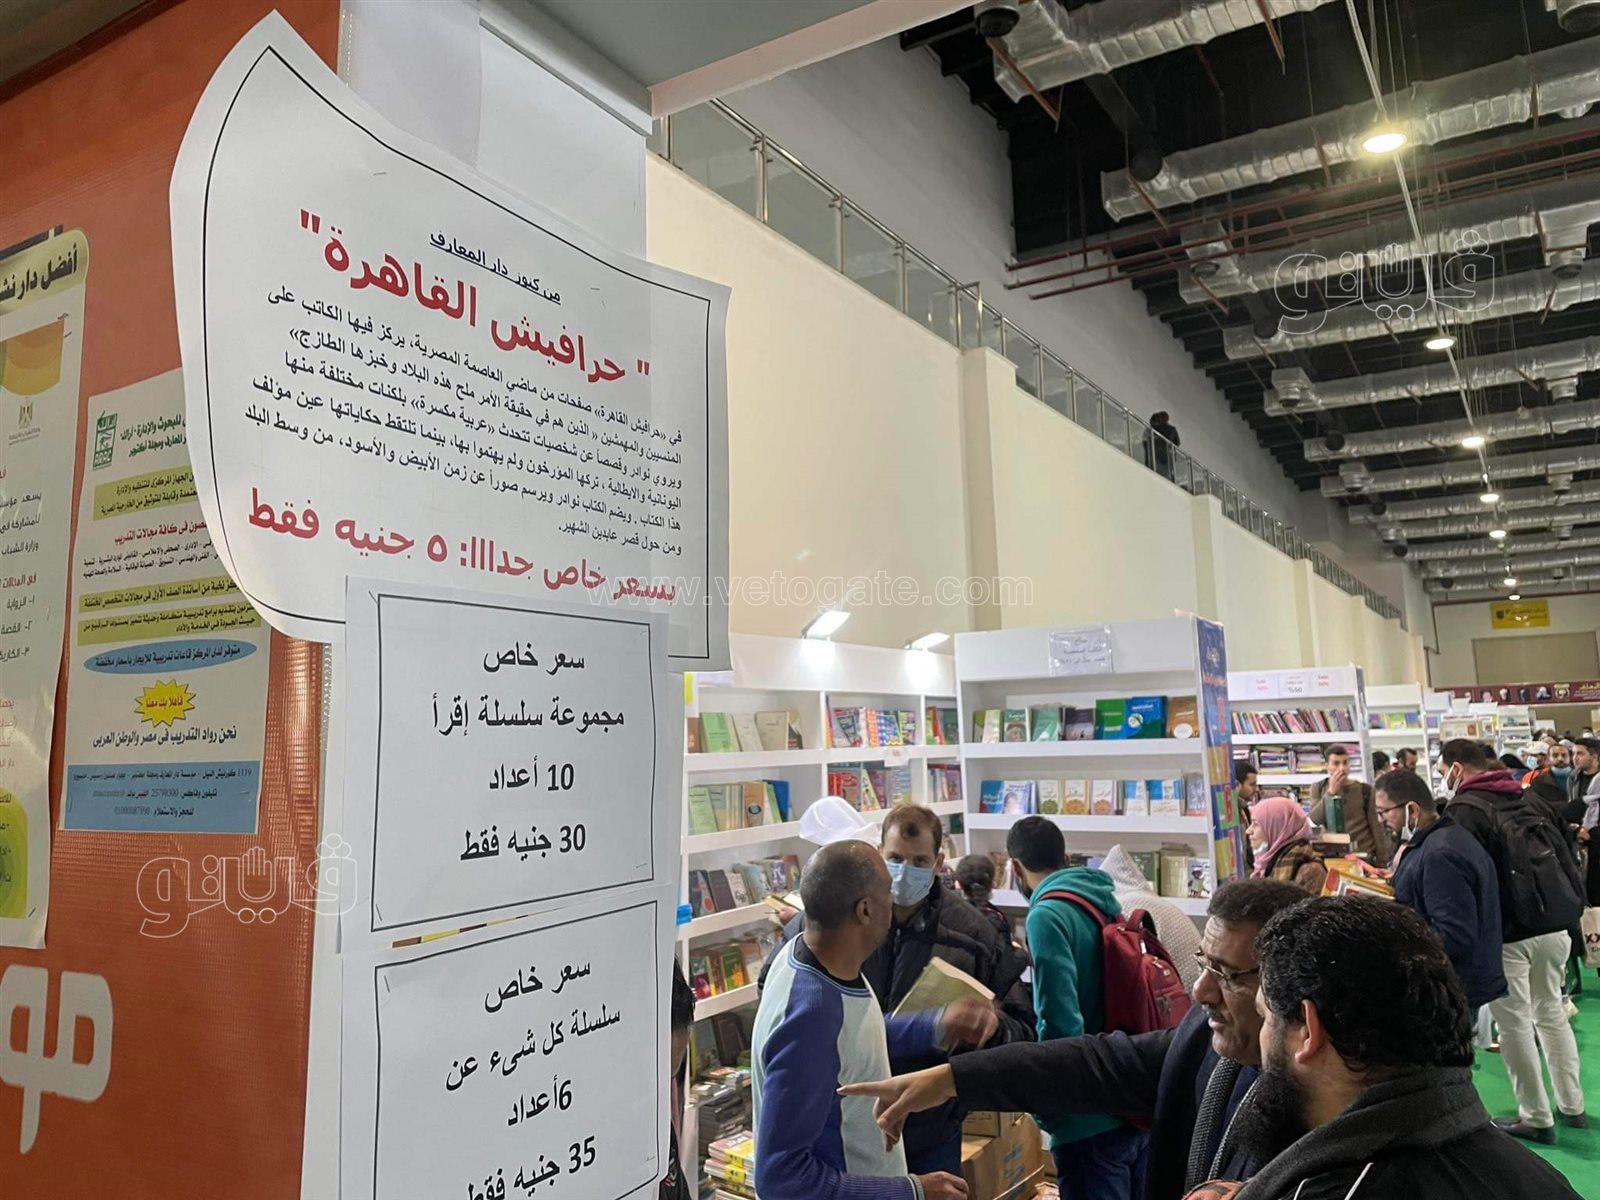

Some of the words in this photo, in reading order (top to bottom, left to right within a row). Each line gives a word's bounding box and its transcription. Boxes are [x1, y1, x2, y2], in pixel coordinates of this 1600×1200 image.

[430, 230, 486, 265] المعارف
[41, 242, 77, 290] أفضل
[491, 258, 508, 275] دار
[0, 274, 15, 301] نش
[17, 269, 37, 300] دار
[514, 272, 539, 291] كنوز
[268, 286, 295, 304] على
[544, 288, 561, 304] من
[302, 300, 343, 322] الكاتب
[347, 312, 373, 333] فيها
[378, 325, 405, 348] يركز
[350, 342, 397, 374] وخبزها
[410, 334, 460, 366] المصرية،
[490, 315, 626, 384] حرافيش
[285, 351, 314, 374] منها
[401, 363, 429, 383] البلاد
[464, 354, 503, 383] العاصمة
[319, 360, 364, 390] مختلفة
[434, 372, 451, 389] هذه
[252, 375, 291, 400] مؤلف
[368, 382, 407, 404] بلكنات
[456, 383, 475, 400] ملح
[506, 378, 537, 394] ماضي
[540, 387, 554, 400] من
[297, 391, 324, 410] عين
[478, 390, 500, 408] الأمر
[504, 396, 533, 418] حقيقة
[558, 393, 592, 413] صفحات
[245, 404, 270, 426] البلد
[330, 397, 382, 425] حكاياتها
[536, 408, 549, 425] في
[274, 412, 309, 439] وسط
[385, 412, 417, 435] تلتقط
[498, 423, 531, 443] تتحدث
[552, 418, 564, 428] هم
[567, 421, 589, 435] الذين
[313, 428, 333, 444] من
[420, 425, 446, 448] بينما
[533, 436, 578, 457] شخصيات
[601, 432, 644, 456] والمهمشين
[669, 430, 682, 445] في
[339, 437, 395, 462] والأسود،
[474, 441, 504, 462] يهتموا
[580, 449, 594, 463] عن
[647, 447, 682, 464] المنسيين
[399, 450, 440, 471] الأبيض
[507, 452, 523, 471] ولم
[527, 460, 574, 480] المؤرخون
[629, 461, 650, 479] نوادر
[444, 464, 467, 481] زمن
[470, 470, 485, 483] عن
[576, 471, 600, 488] تركها
[653, 474, 682, 488] ويروي
[521, 486, 553, 503] ويرسم
[556, 494, 580, 509] نوادر
[648, 490, 682, 509] اليونانية
[248, 487, 319, 540] فقط
[582, 498, 607, 514] الكتاب
[609, 507, 632, 523] ويضم
[558, 520, 590, 534] الشهير.
[640, 510, 665, 527] الكتاب
[667, 518, 681, 531] هذا
[333, 518, 415, 560] جنيه
[592, 525, 617, 541] عابدين
[621, 531, 639, 546] قصر
[642, 537, 660, 552] حول
[662, 543, 682, 555] ومن
[543, 559, 606, 591] خاص
[613, 575, 676, 604] بسعر
[483, 641, 538, 673] خاص
[546, 650, 585, 676] سعر
[432, 692, 469, 737] إقرأ
[478, 694, 543, 727] سلسلة
[550, 696, 625, 734] مجموعة
[140, 733, 157, 745] مصر
[170, 727, 200, 745] التدريب
[202, 726, 217, 743] رواد
[219, 725, 237, 743] نحن
[489, 754, 538, 790] أعداد
[547, 763, 575, 792] 10
[460, 824, 500, 861] فقط
[507, 824, 551, 862] جنيه
[559, 823, 586, 854] 30
[552, 961, 591, 994] سعر
[484, 965, 543, 1013] خاص
[571, 1004, 620, 1037] سلسلة
[542, 1020, 564, 1055] كل
[445, 1055, 478, 1091] عن
[568, 1135, 596, 1174] 35
[514, 1154, 560, 1197] جنيه
